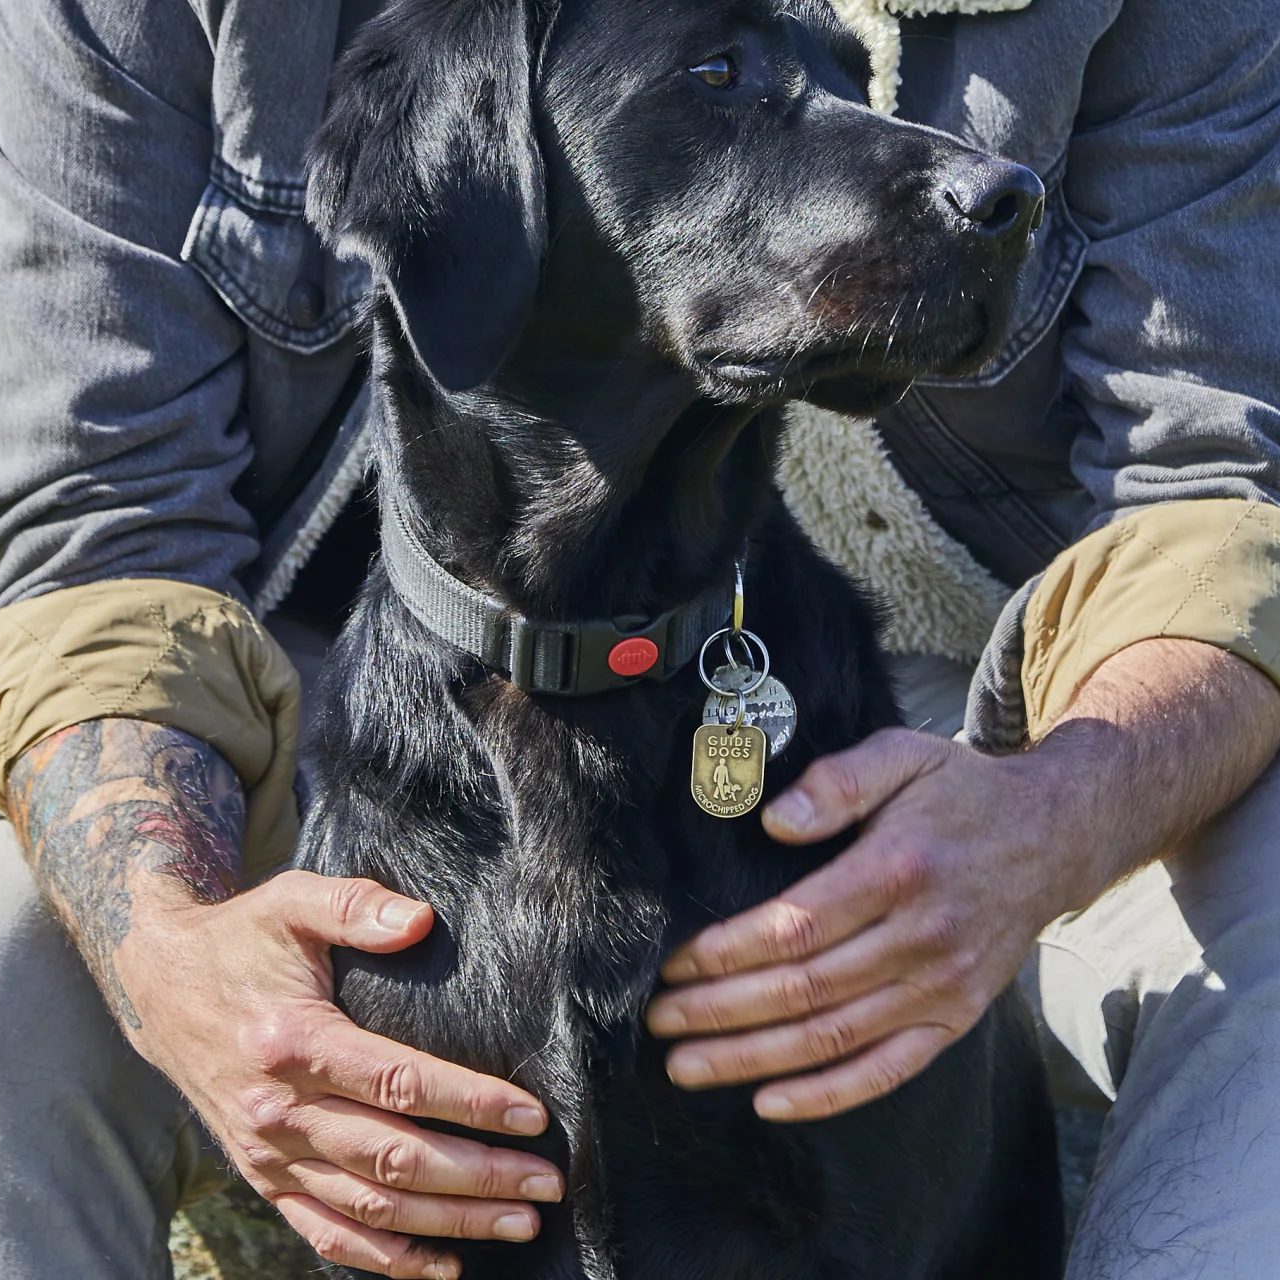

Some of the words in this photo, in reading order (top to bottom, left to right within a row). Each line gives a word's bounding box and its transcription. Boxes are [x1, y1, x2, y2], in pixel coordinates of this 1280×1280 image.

[708, 735, 752, 748] GUIDE
[708, 746, 750, 758] DOGS
[694, 784, 745, 814] MICROCHIPPED
[744, 787, 759, 806] DOG
